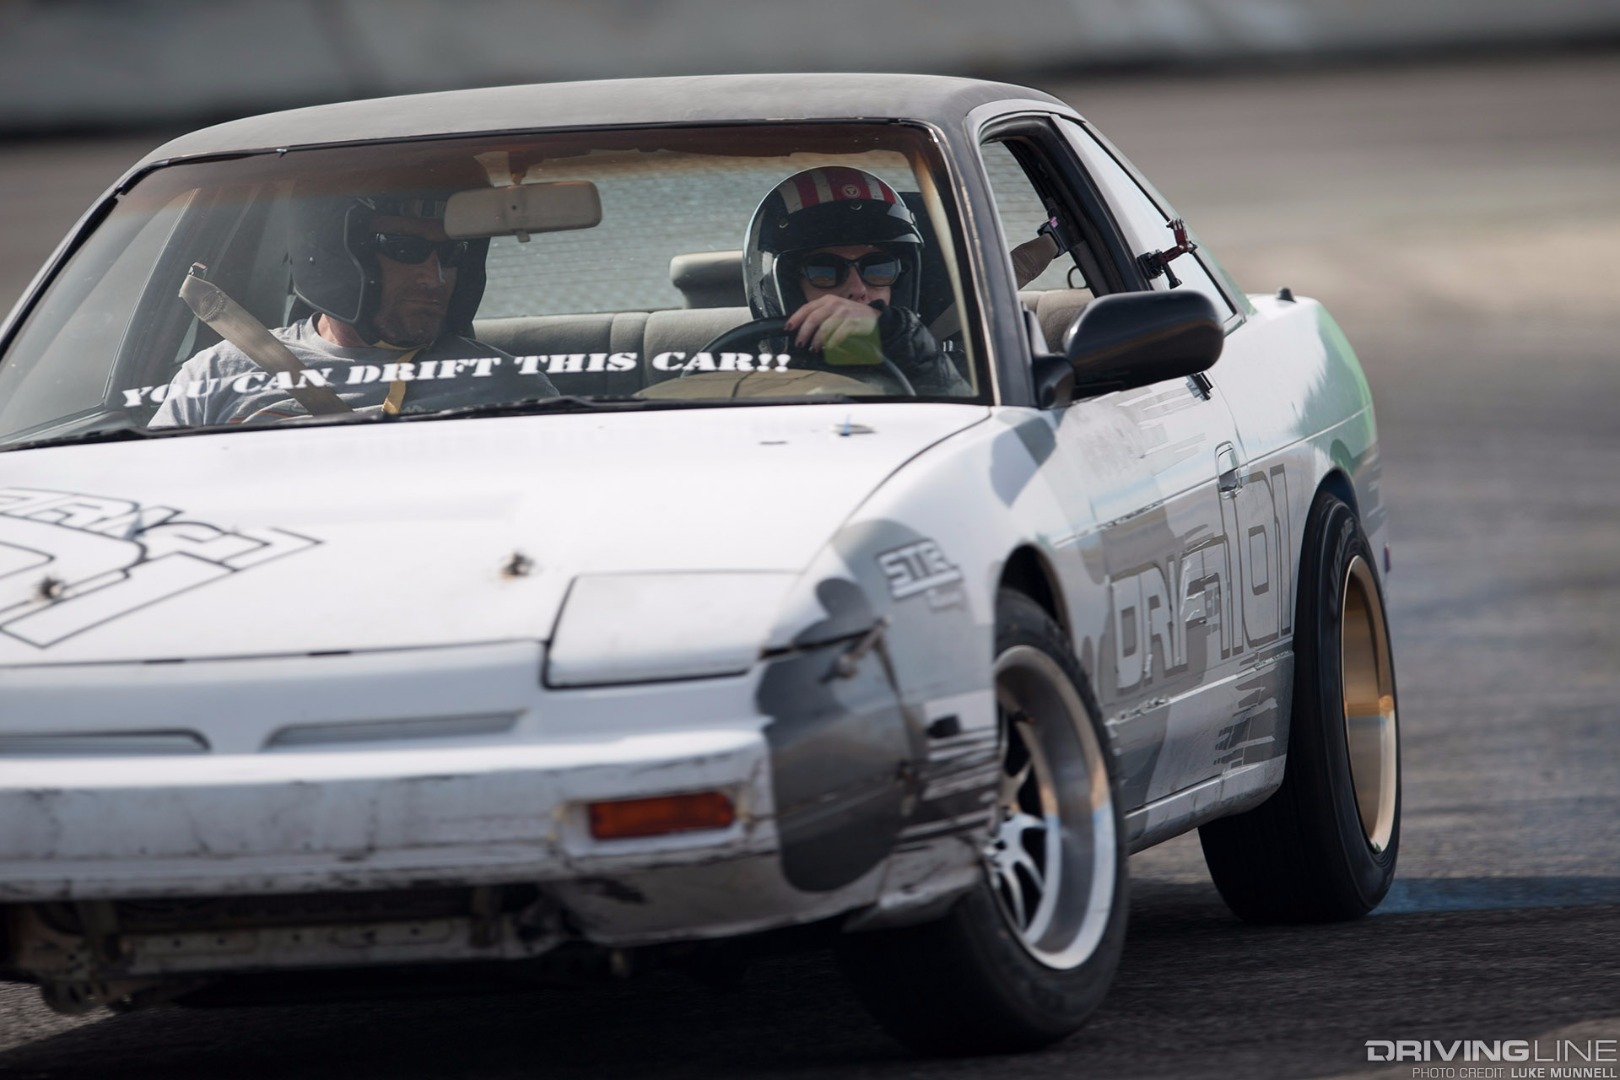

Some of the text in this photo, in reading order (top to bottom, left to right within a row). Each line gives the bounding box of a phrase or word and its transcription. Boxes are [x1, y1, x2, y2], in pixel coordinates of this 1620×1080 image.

[232, 368, 334, 394] CAN
[345, 357, 502, 384] DRIFT
[514, 352, 638, 375] THIS
[652, 351, 792, 373] CAR!!
